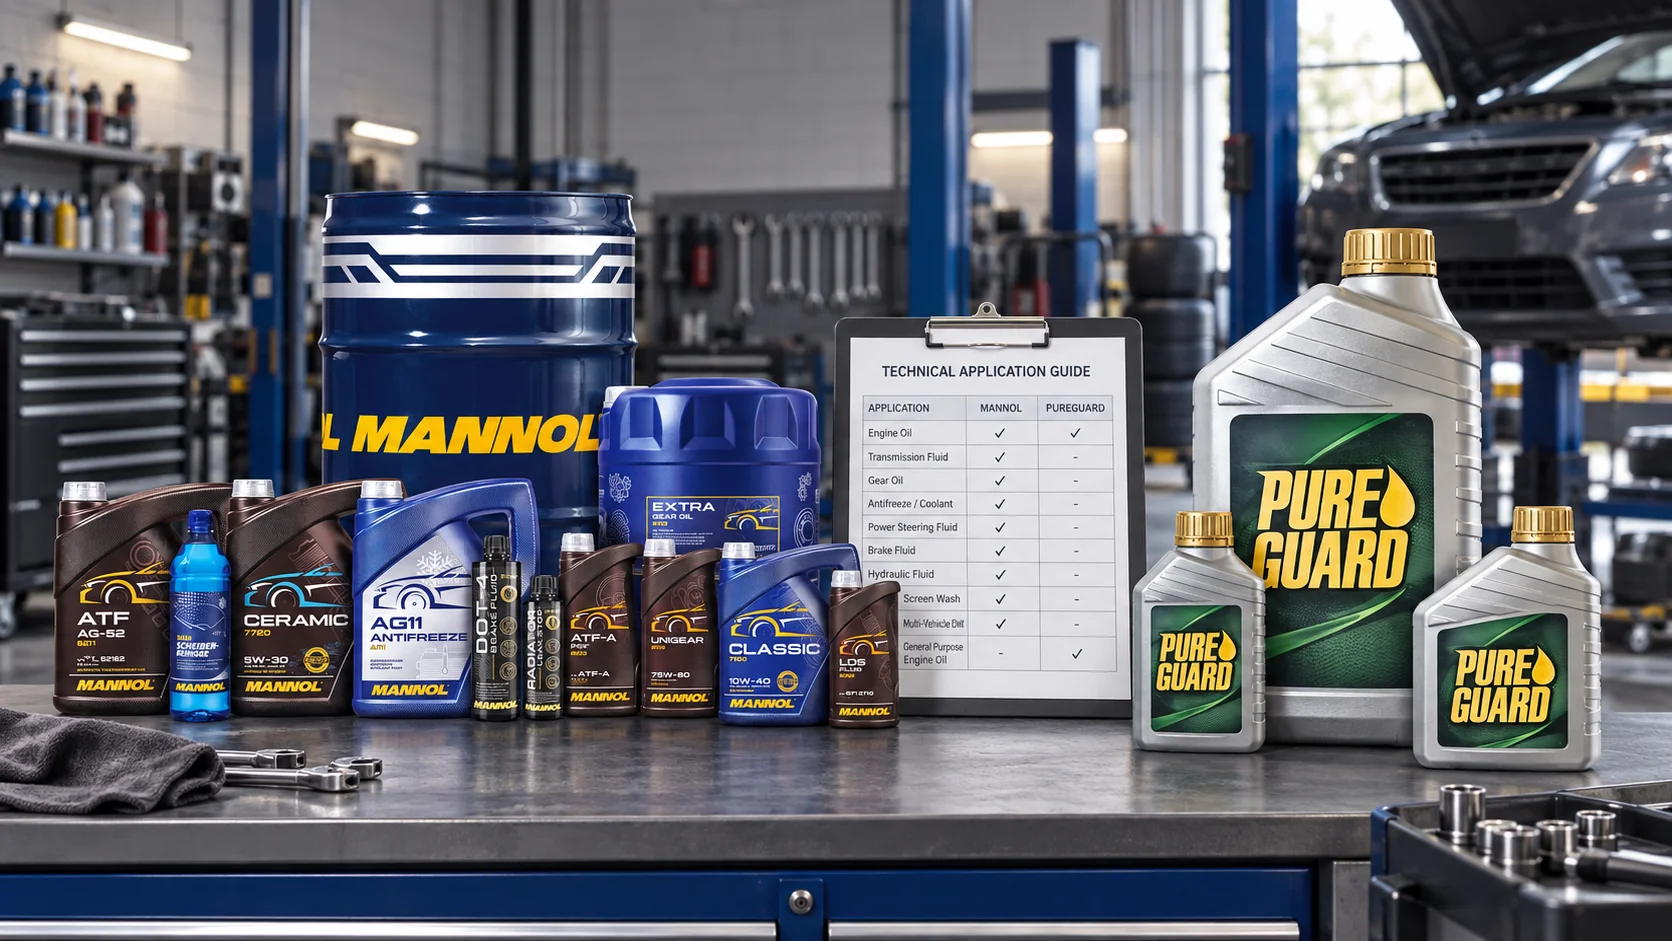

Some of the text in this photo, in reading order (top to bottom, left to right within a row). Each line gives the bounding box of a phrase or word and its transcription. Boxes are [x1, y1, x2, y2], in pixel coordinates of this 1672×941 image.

[882, 365, 1091, 378] TECHNICAL APPLICATION GUIDE
[868, 403, 930, 413] APPLICATION
[980, 403, 1022, 413] MANNOL
[1046, 403, 1105, 413] PUREGUARD
[351, 413, 600, 454] MANNOL
[868, 428, 912, 439] Engine Oil
[868, 452, 949, 462] Transmission Fluid
[868, 475, 904, 485] Gear Oil
[867, 499, 912, 509] Antifreeze
[919, 499, 953, 509] Coolant
[1257, 468, 1384, 531] PURE
[652, 501, 716, 512] EXTRA
[868, 522, 958, 534] Power Steering Fluid
[868, 545, 916, 555] Brake Fluid
[1252, 529, 1409, 590] GUARD
[868, 569, 934, 580] Hydraulic Fluid
[903, 593, 961, 604] Screen Wash
[77, 611, 130, 626] ATF
[476, 575, 489, 654] DOT-4
[243, 614, 349, 627] CERAMIC
[370, 616, 423, 630] AG11
[77, 629, 126, 638] AG-52
[370, 632, 468, 642] ANTIFREEZE
[570, 633, 617, 642] ATF-A
[650, 636, 704, 644] UNIGEAR
[728, 643, 821, 656] CLASSIC
[903, 641, 964, 653] General Purpose
[1158, 631, 1219, 662] PURE
[243, 655, 289, 664] 5W-30
[839, 658, 866, 667] LDS
[903, 655, 947, 667] Engine Oil
[1455, 647, 1534, 687] PURE
[728, 677, 771, 685] 10W-40
[1156, 661, 1232, 692] GUARD
[76, 679, 155, 692] MANNOL
[175, 681, 226, 692] MANNOL
[245, 680, 323, 693] MANNOL
[371, 684, 449, 696] MANNOL
[570, 691, 630, 702] MANNOL
[650, 693, 709, 703] MANNOL
[729, 698, 795, 709] MANNOL
[1450, 686, 1552, 724] GUARD
[838, 707, 891, 716] MANNOL
